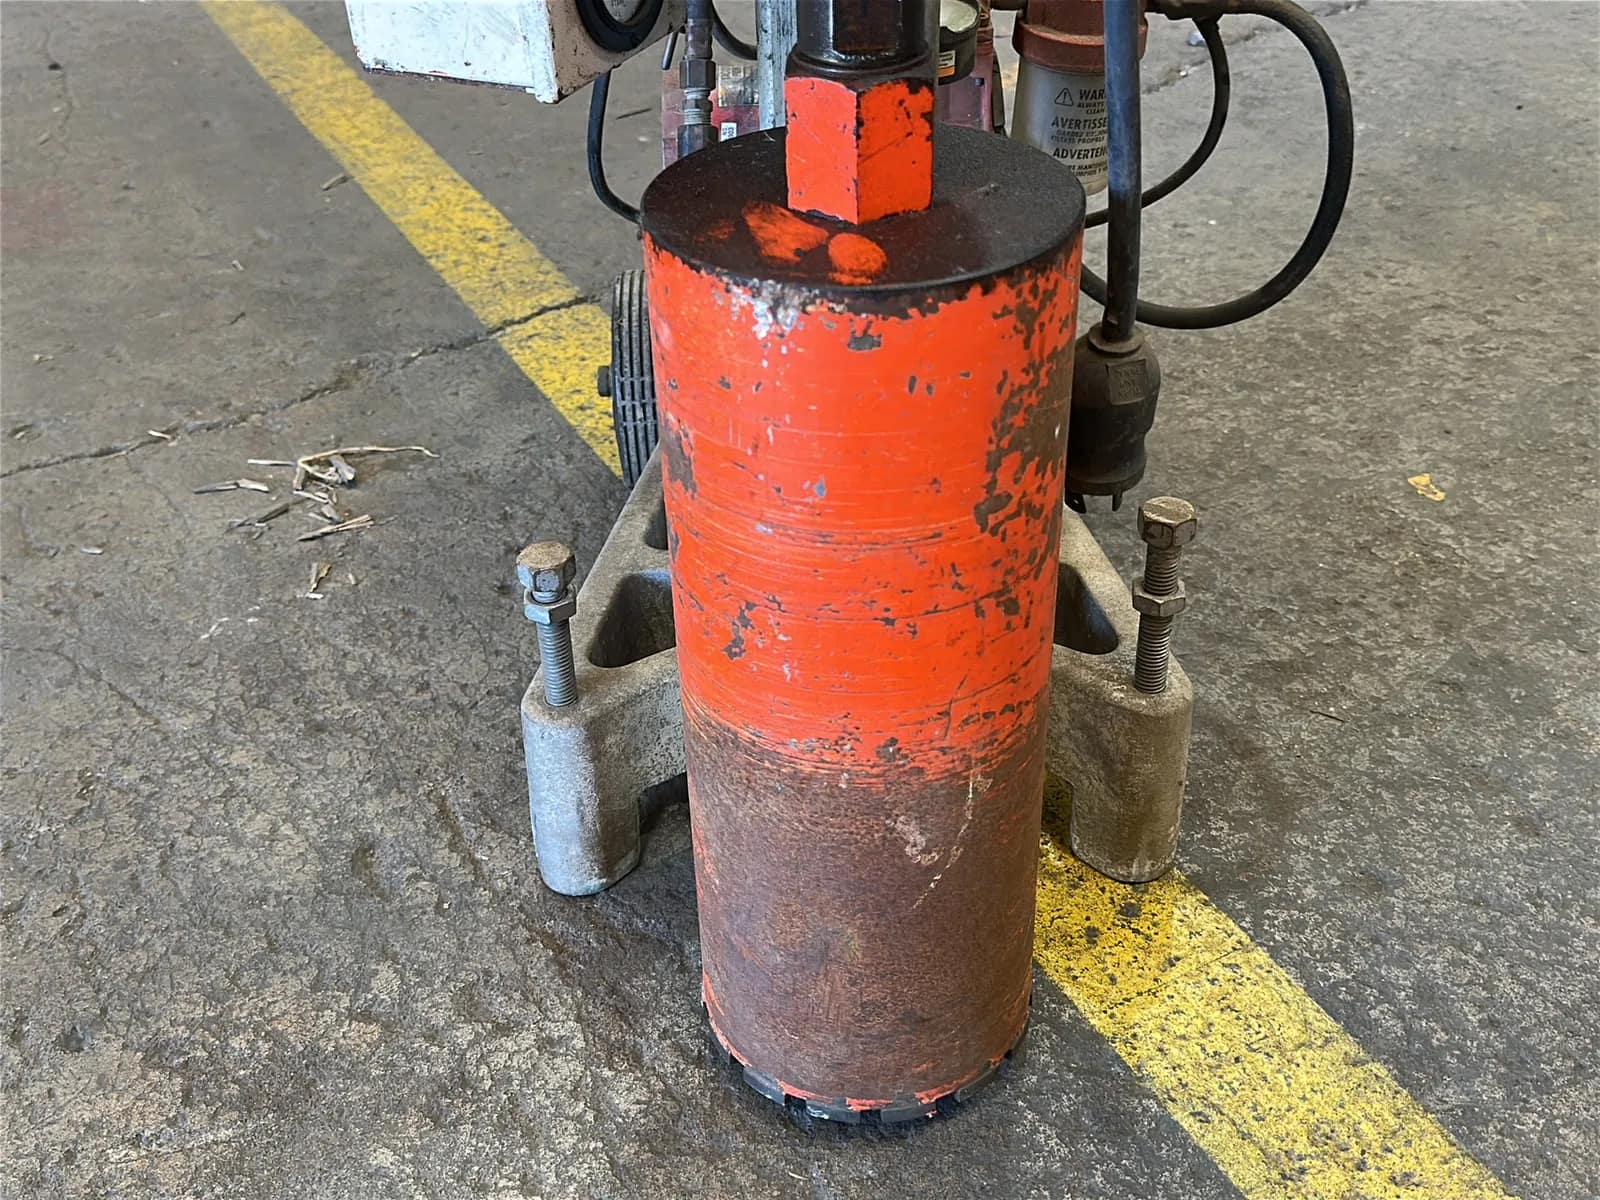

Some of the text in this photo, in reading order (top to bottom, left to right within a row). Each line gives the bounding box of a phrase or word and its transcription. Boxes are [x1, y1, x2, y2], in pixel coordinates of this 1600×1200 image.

[1079, 88, 1105, 101] WAR
[1051, 116, 1107, 130] AVERTISSE
[1053, 146, 1107, 160] ADVERTEN
